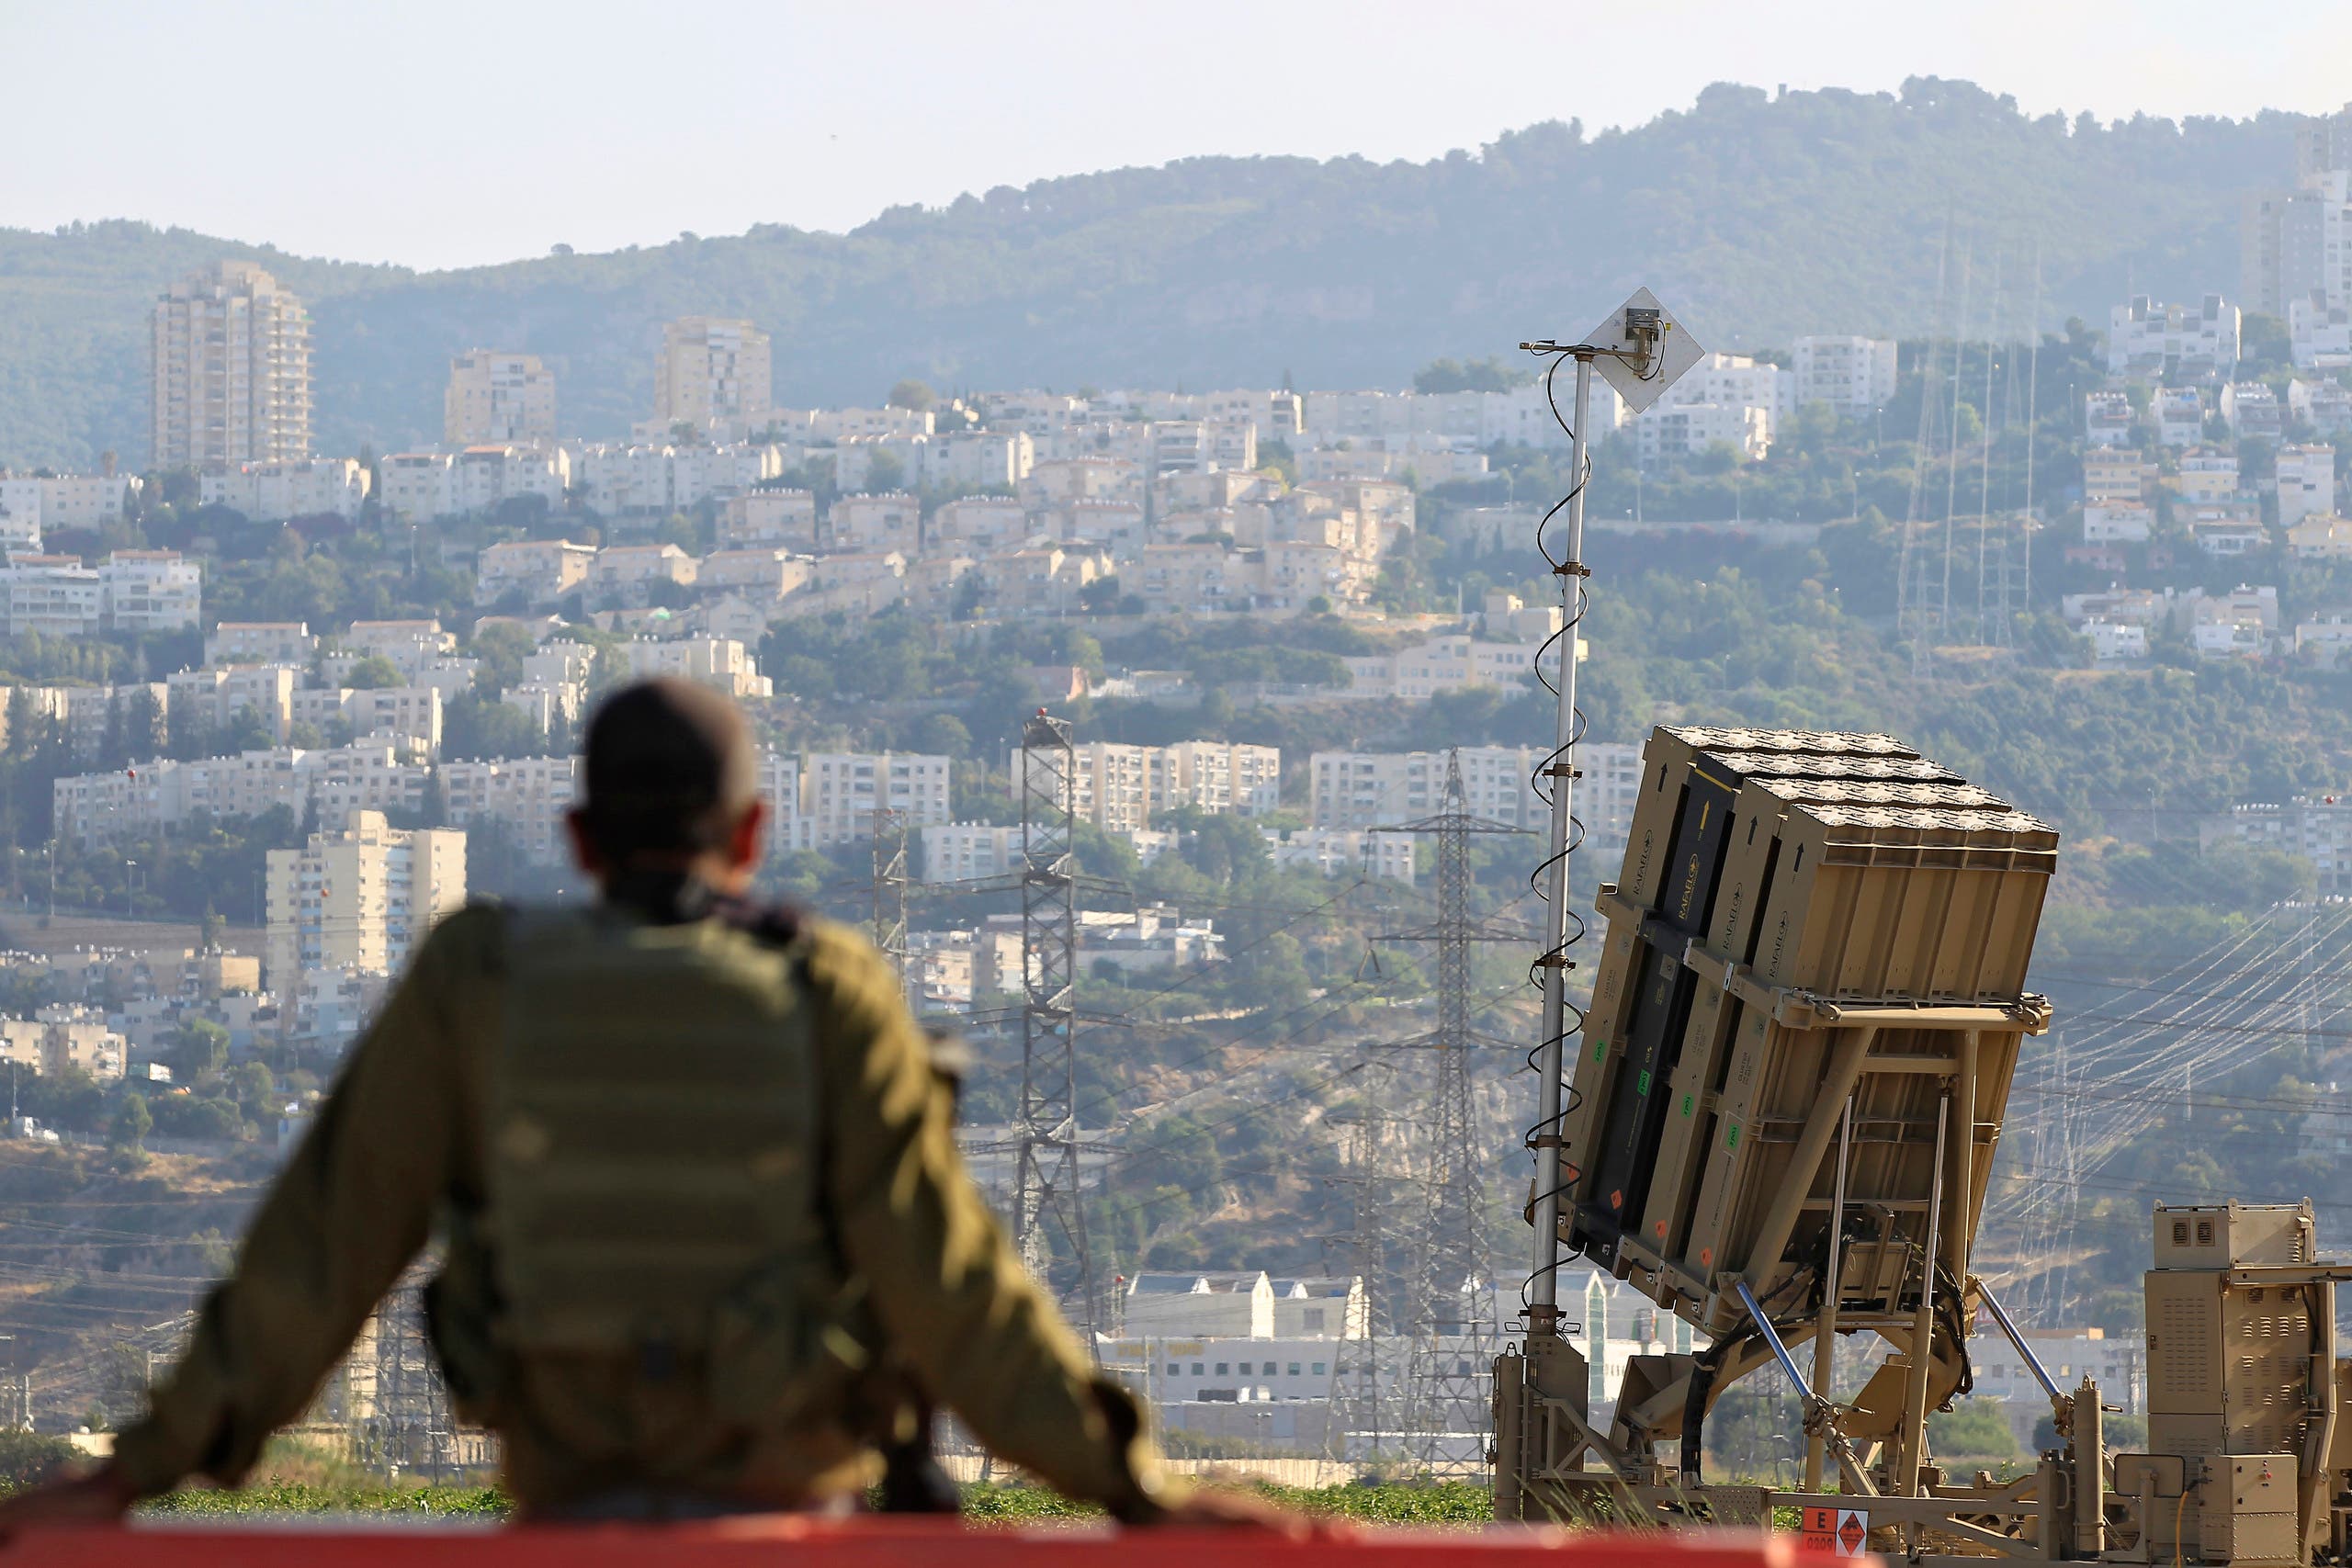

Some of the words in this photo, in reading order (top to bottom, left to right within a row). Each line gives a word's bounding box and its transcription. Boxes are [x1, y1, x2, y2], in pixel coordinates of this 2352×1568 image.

[1633, 852, 1648, 895] RAFAEL
[1679, 877, 1694, 919] RAFAEL
[1723, 908, 1737, 950] RAFAEL
[1769, 935, 1783, 977] RAFAEL
[1817, 1512, 1826, 1529] E
